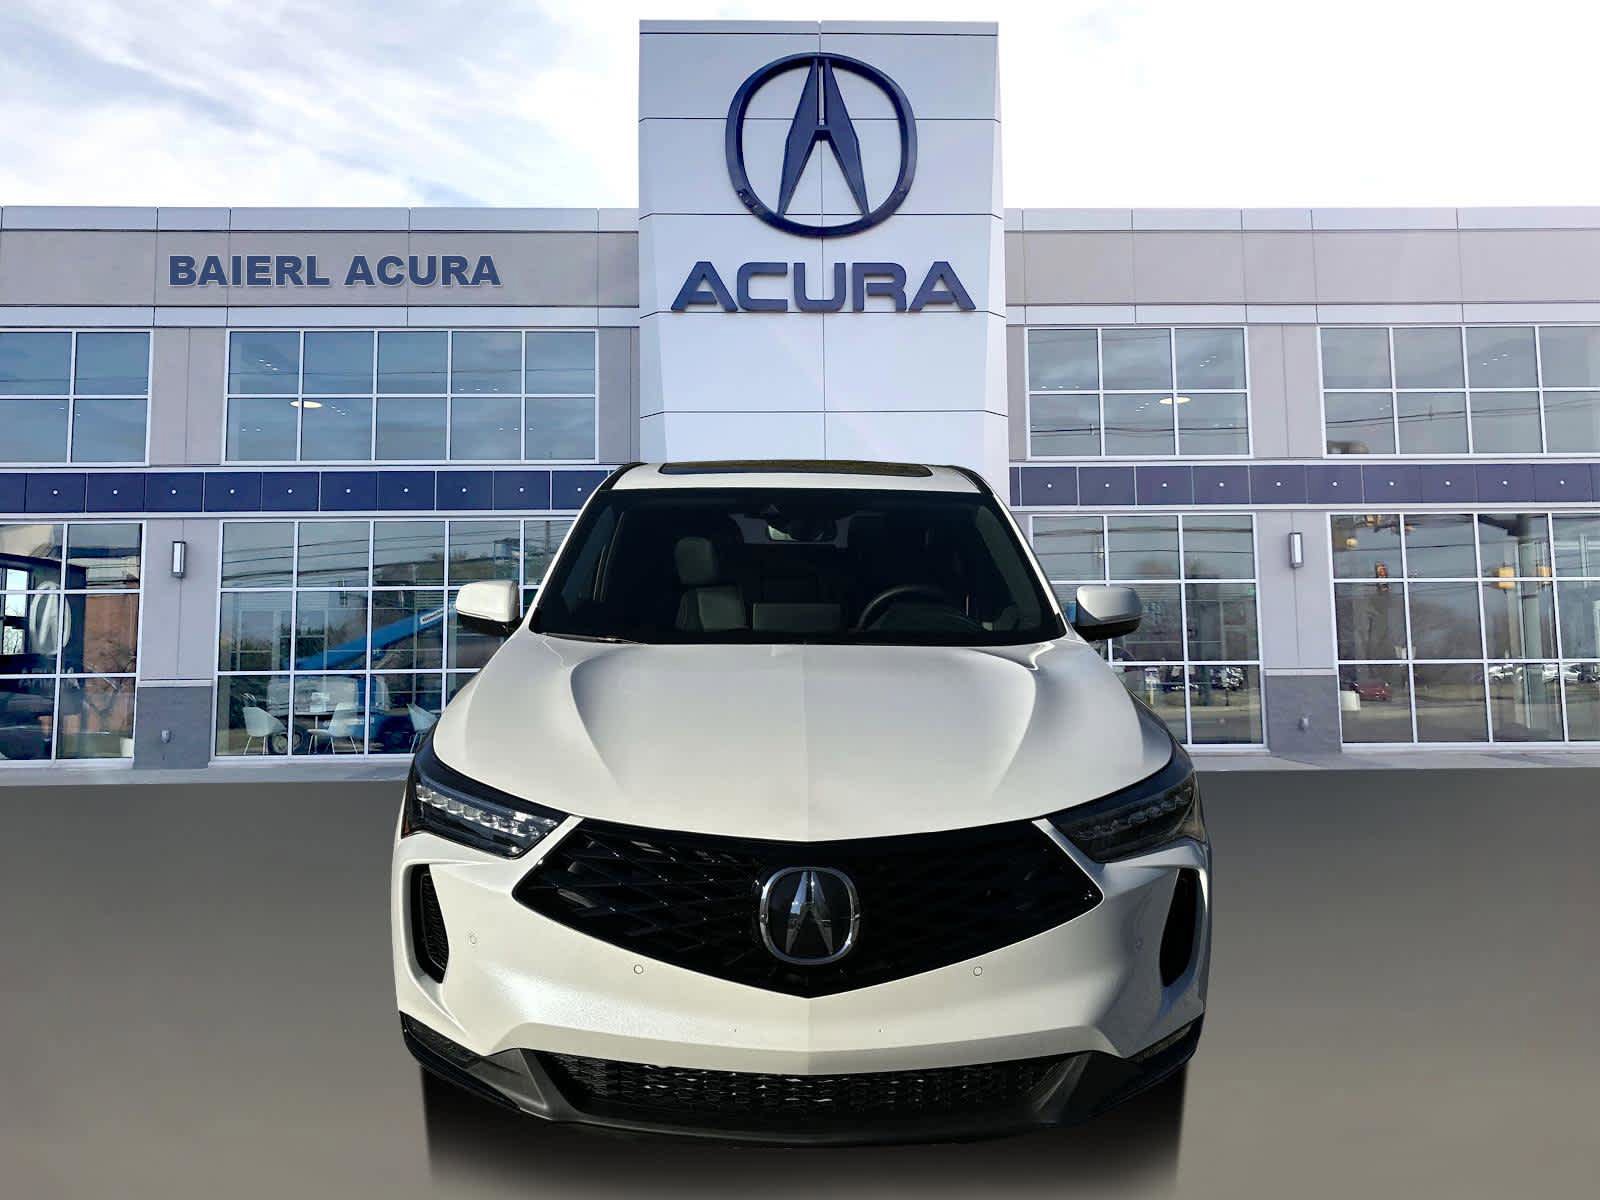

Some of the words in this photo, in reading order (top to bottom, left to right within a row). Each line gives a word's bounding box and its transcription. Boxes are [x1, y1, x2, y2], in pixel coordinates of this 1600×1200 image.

[168, 254, 331, 287] BAIERL
[343, 254, 502, 287] ACURA
[671, 260, 977, 314] ACURA
